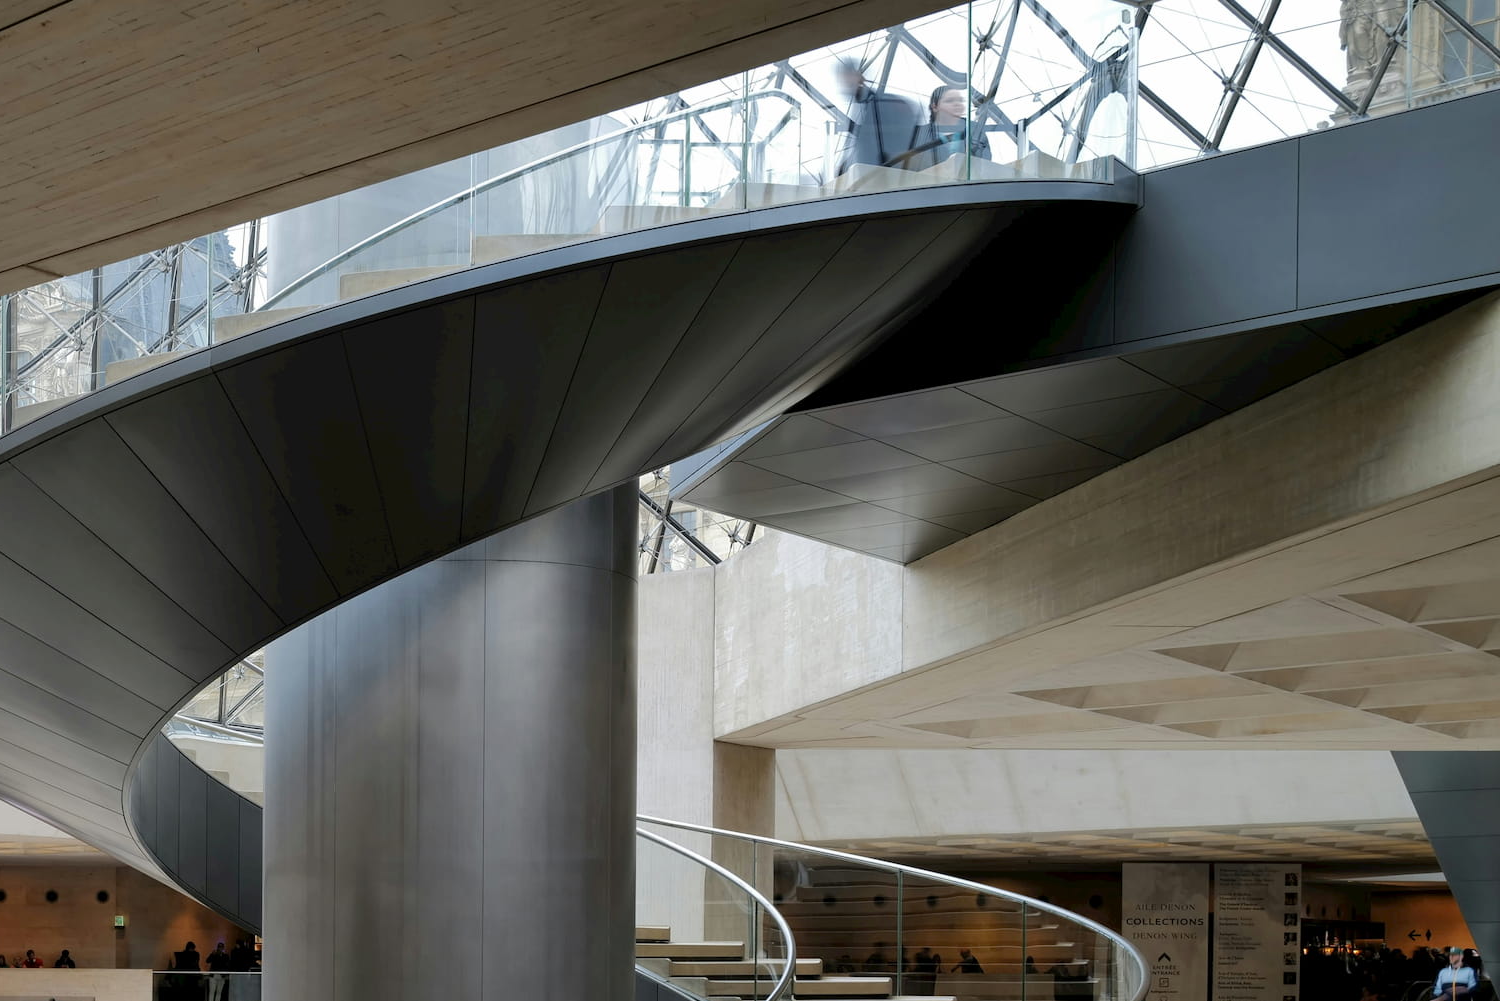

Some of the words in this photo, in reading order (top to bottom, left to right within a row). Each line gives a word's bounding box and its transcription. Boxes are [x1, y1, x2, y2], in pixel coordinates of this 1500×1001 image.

[1126, 918, 1204, 926] COLLECTIONS
[1133, 932, 1167, 940] DENON
[1171, 932, 1197, 940] WING
